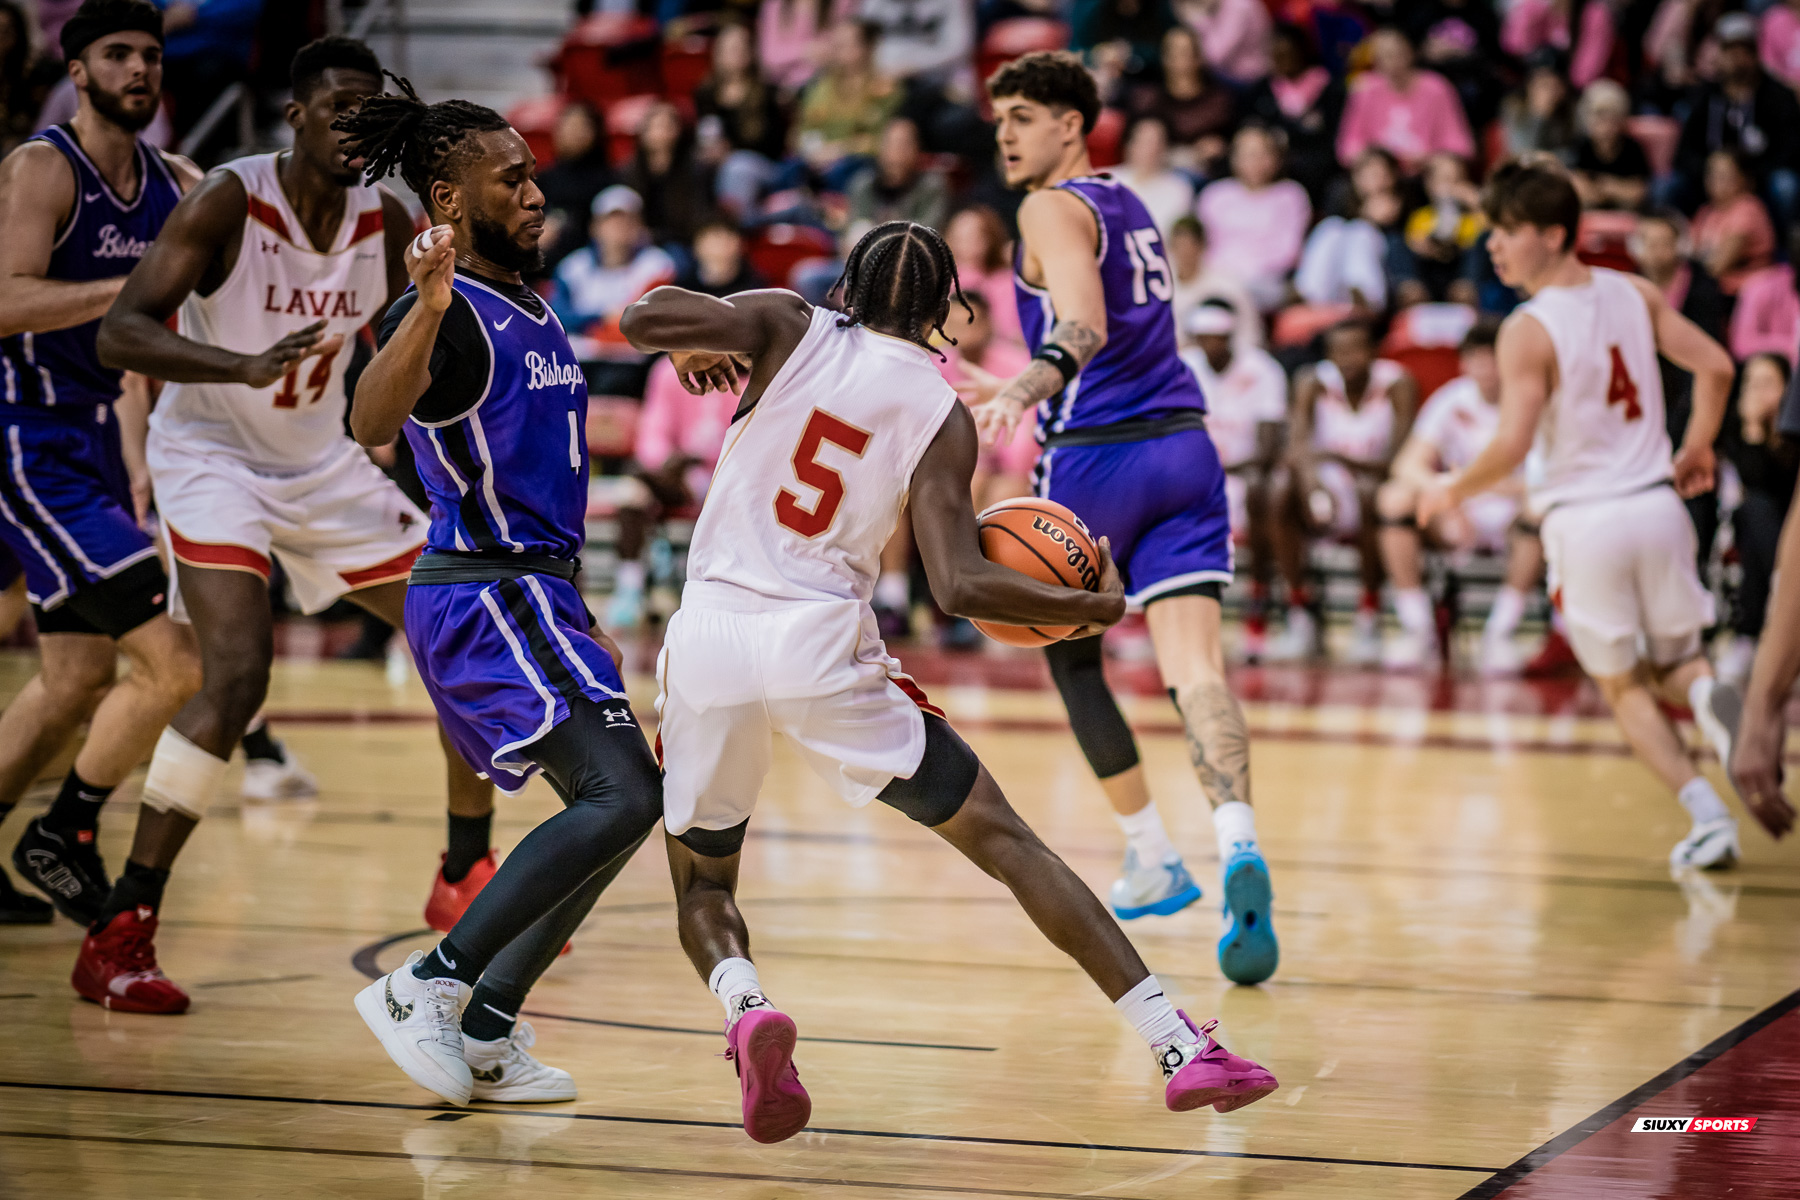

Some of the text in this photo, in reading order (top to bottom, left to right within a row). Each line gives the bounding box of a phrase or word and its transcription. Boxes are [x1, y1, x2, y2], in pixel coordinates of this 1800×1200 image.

[264, 284, 362, 318] LAVAL
[1123, 227, 1173, 305] 15
[272, 332, 345, 409] 14
[1606, 343, 1643, 422] 4
[772, 405, 875, 541] 5
[1032, 515, 1099, 593] Wilson
